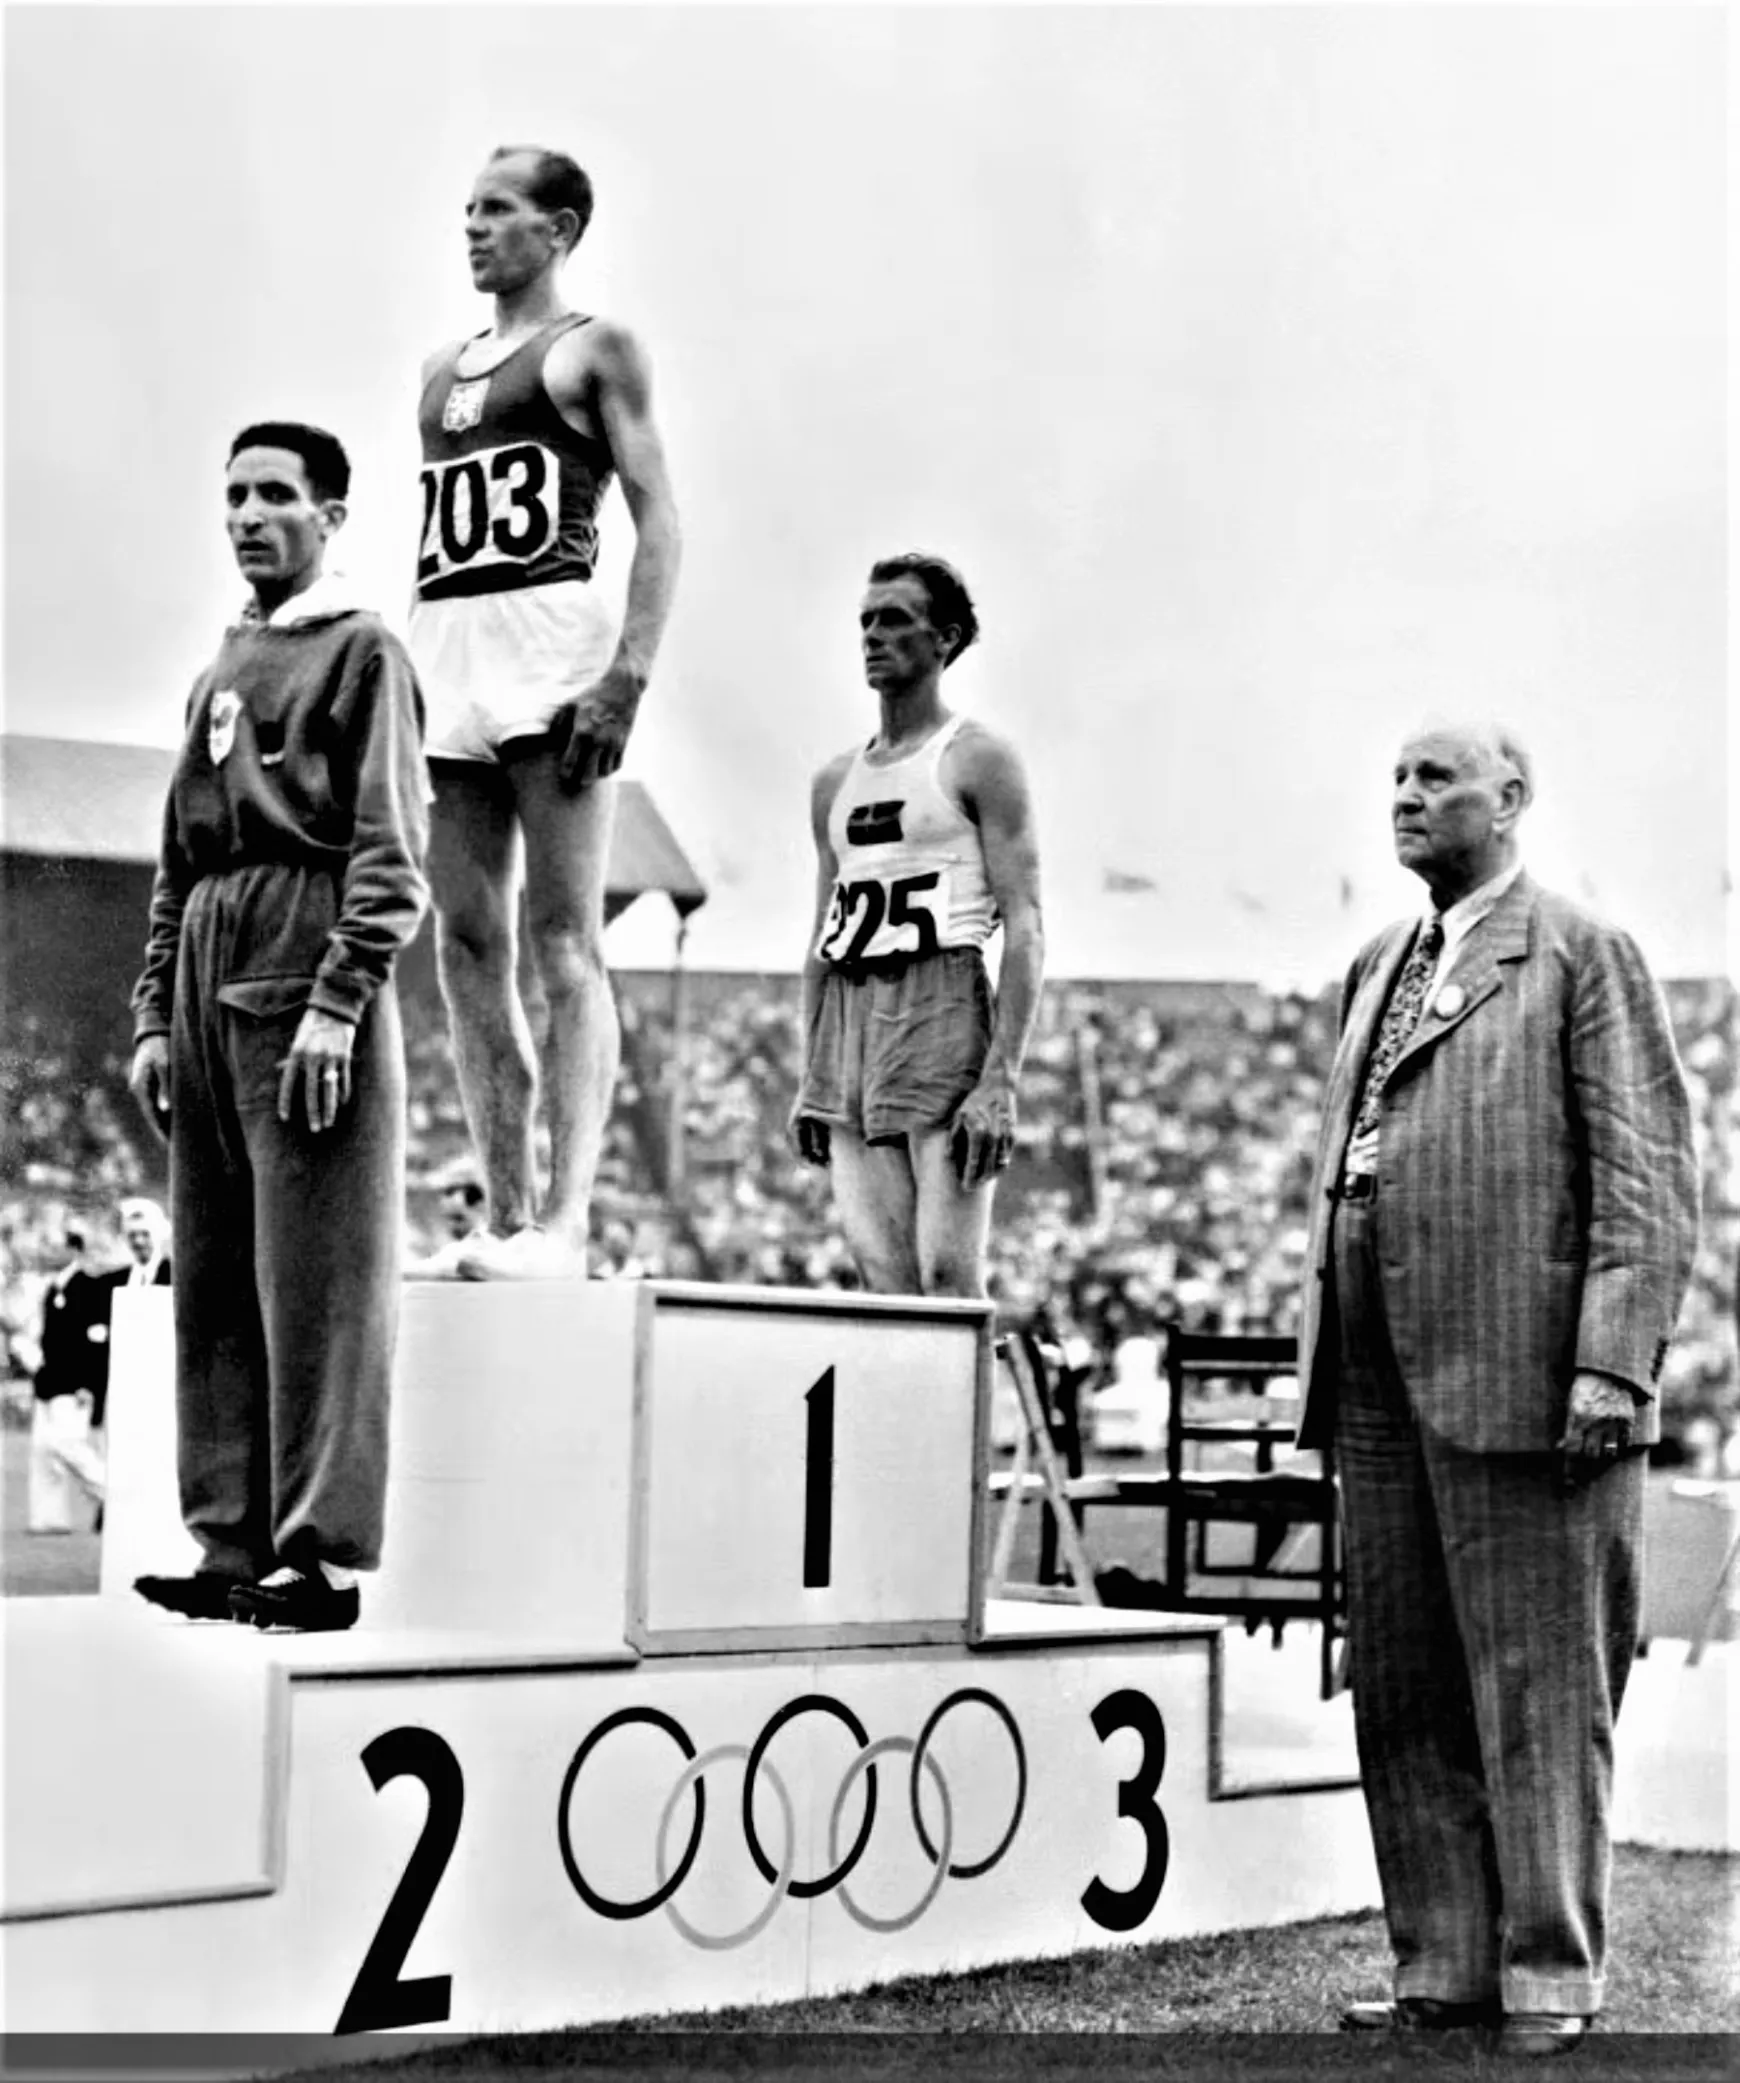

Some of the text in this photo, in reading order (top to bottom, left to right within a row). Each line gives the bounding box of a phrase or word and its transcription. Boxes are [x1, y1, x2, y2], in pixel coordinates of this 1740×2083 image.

[803, 1364, 835, 1589] 1
[332, 1726, 465, 2035] 2
[1080, 1688, 1170, 1932] 3
